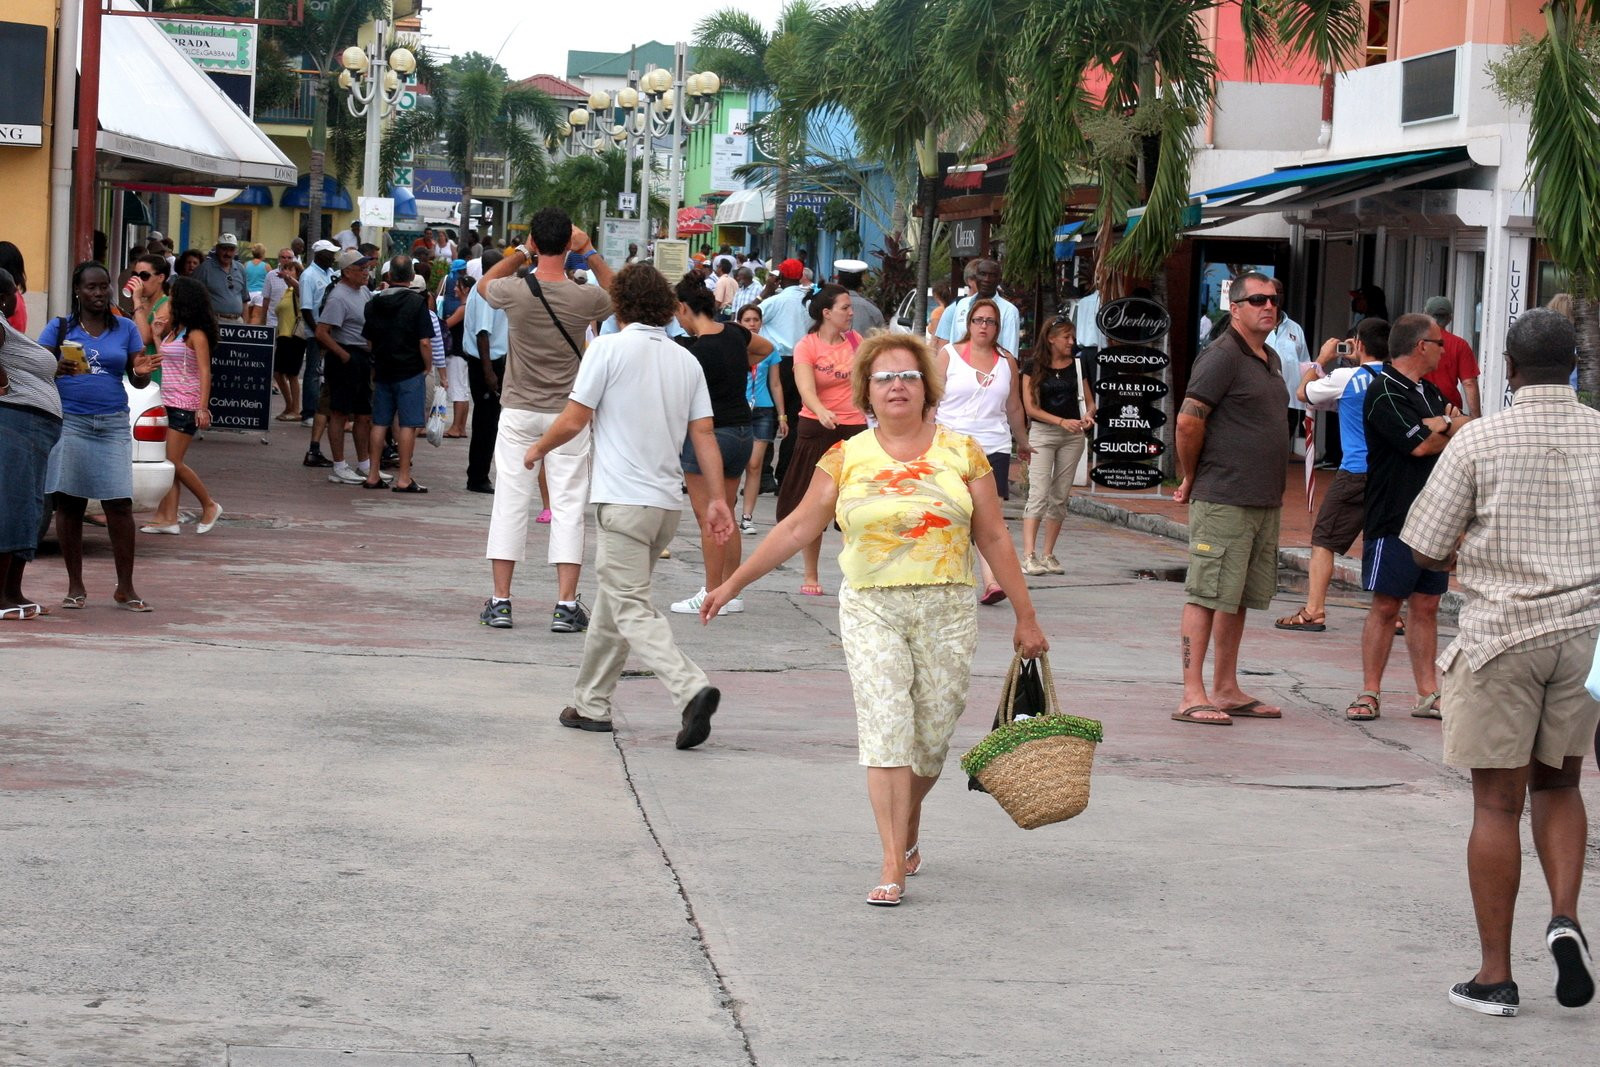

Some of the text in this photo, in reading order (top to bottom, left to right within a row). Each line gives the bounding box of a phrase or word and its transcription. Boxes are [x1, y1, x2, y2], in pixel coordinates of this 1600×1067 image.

[183, 48, 236, 58] LCE&GABBANA
[763, 141, 794, 153] SHP
[1101, 302, 1167, 334] Sterlings
[219, 328, 268, 339] EW GATES
[1099, 355, 1165, 365] PIANEGONDA
[1101, 382, 1162, 392] CHARRIOL
[210, 397, 262, 409] Calvin Klein
[211, 416, 260, 426] LACOSTE
[1109, 418, 1151, 429] FESTINA
[1100, 441, 1148, 453] swatch
